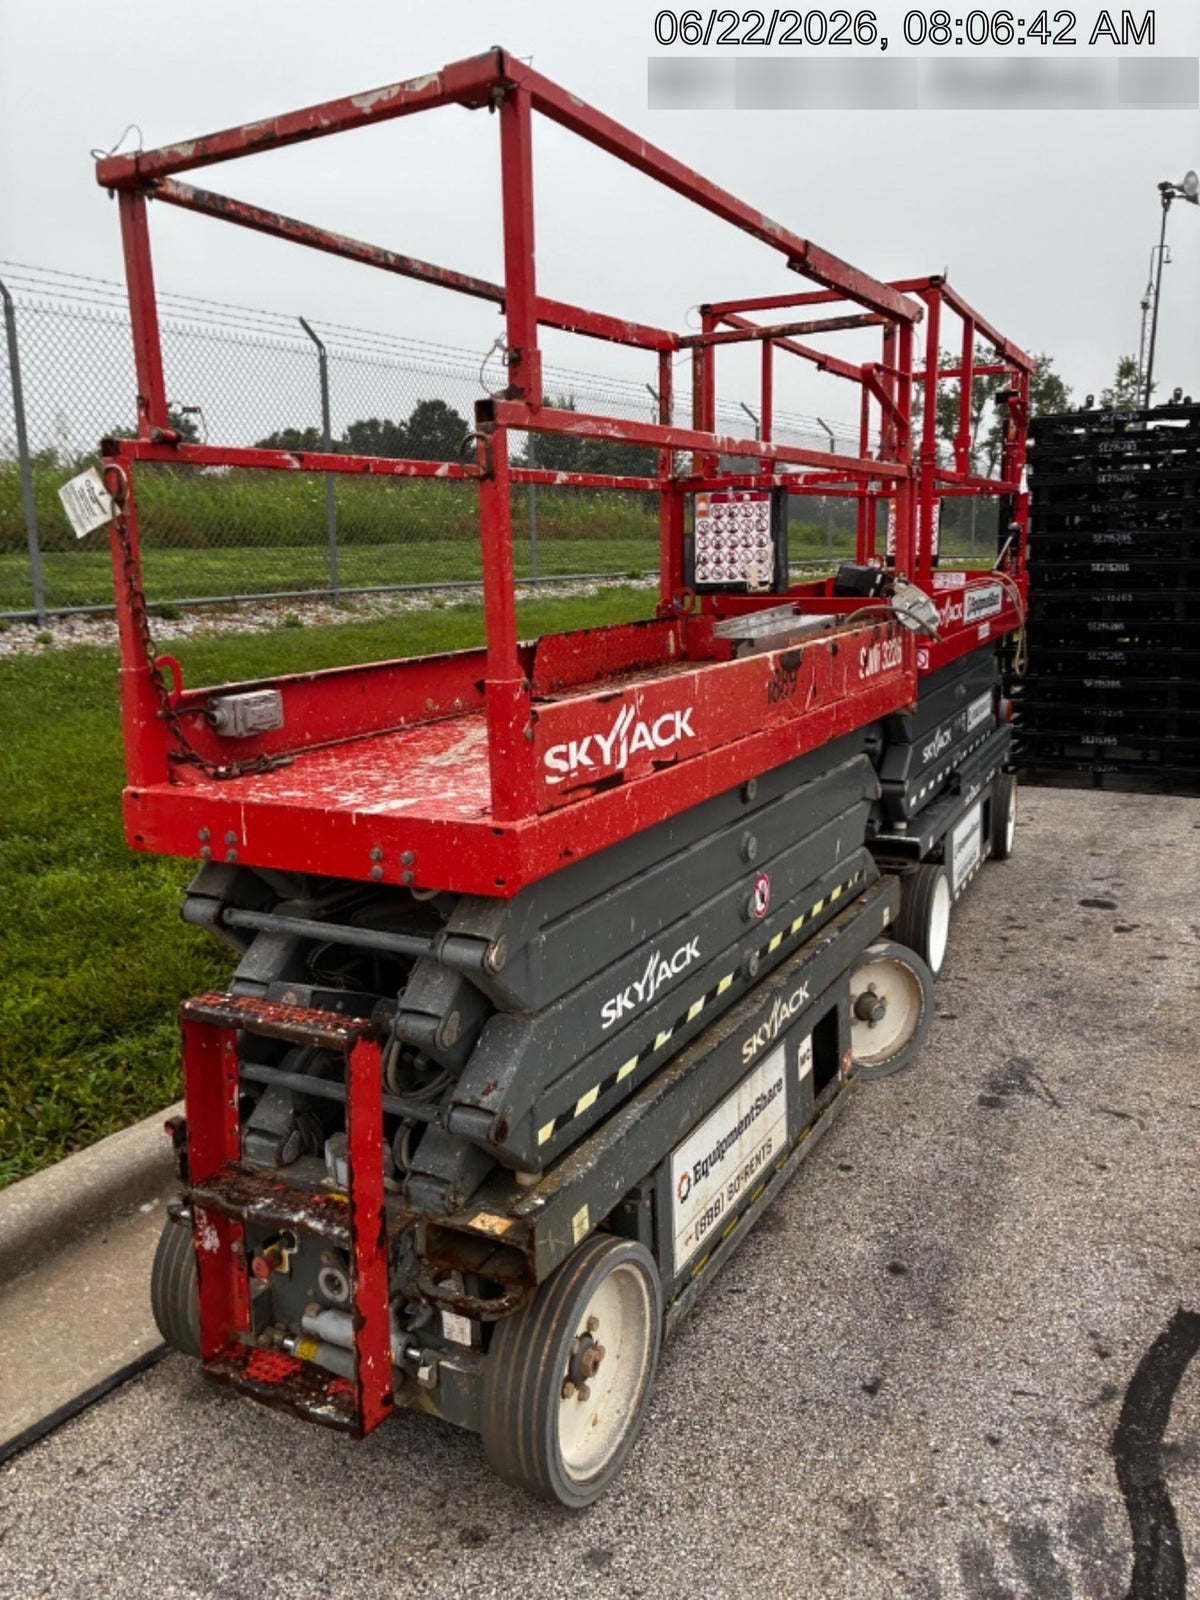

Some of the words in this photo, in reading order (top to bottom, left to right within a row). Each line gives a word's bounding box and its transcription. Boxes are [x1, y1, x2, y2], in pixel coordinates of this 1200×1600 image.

[543, 703, 696, 785] SKYJACK
[600, 935, 701, 1030] SKYJACK
[742, 980, 810, 1065] SKYJACK
[692, 1077, 783, 1187] EquipmentShare
